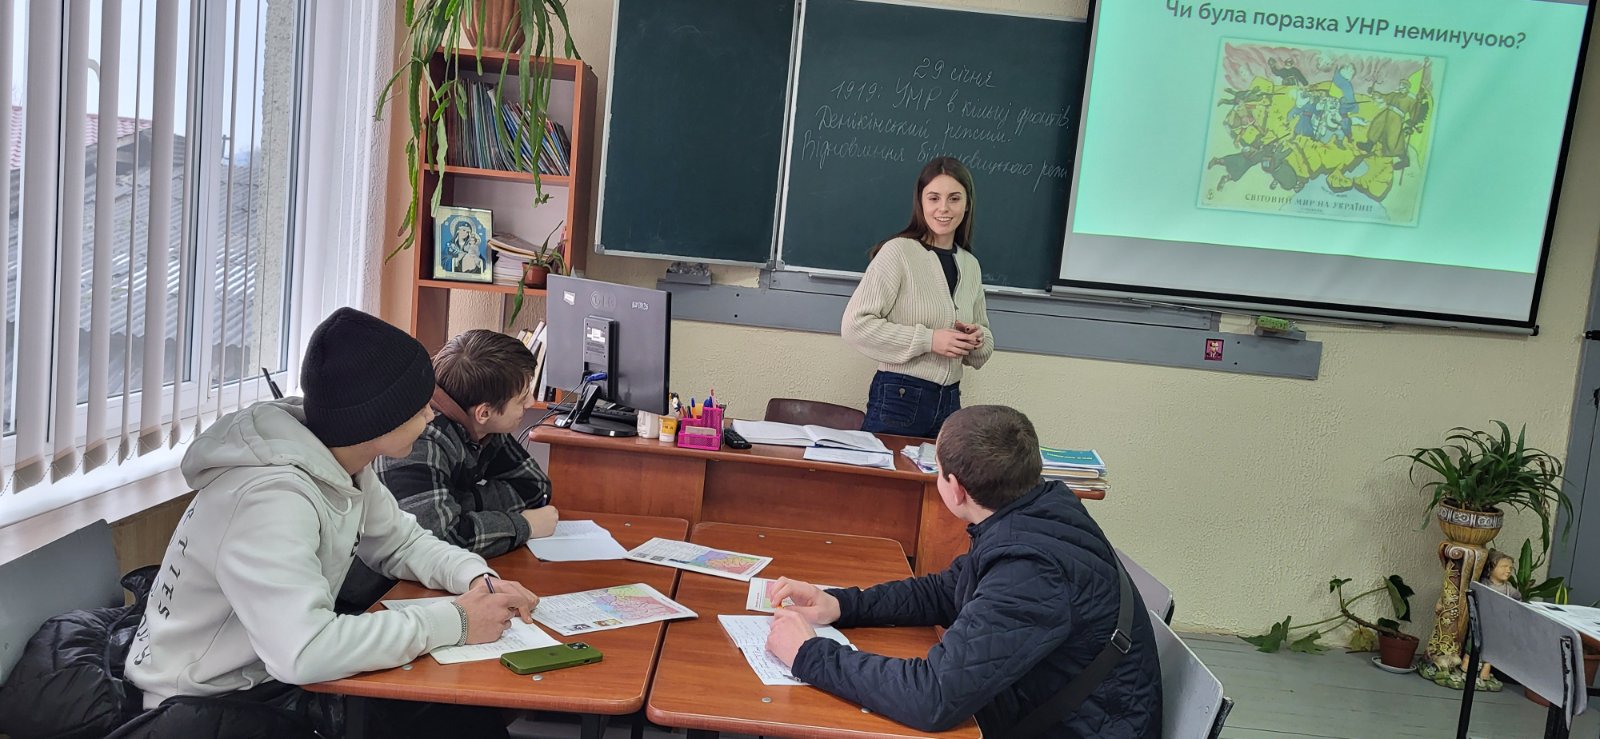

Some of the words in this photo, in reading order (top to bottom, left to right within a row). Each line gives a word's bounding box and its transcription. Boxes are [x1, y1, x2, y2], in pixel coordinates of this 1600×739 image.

[1165, 0, 1193, 19] Чи
[1198, 2, 1247, 26] була
[1252, 11, 1339, 32] поразка
[1345, 15, 1390, 36] УНР
[1393, 24, 1527, 50] неминучою?
[912, 57, 945, 80] 29
[946, 88, 959, 113] в
